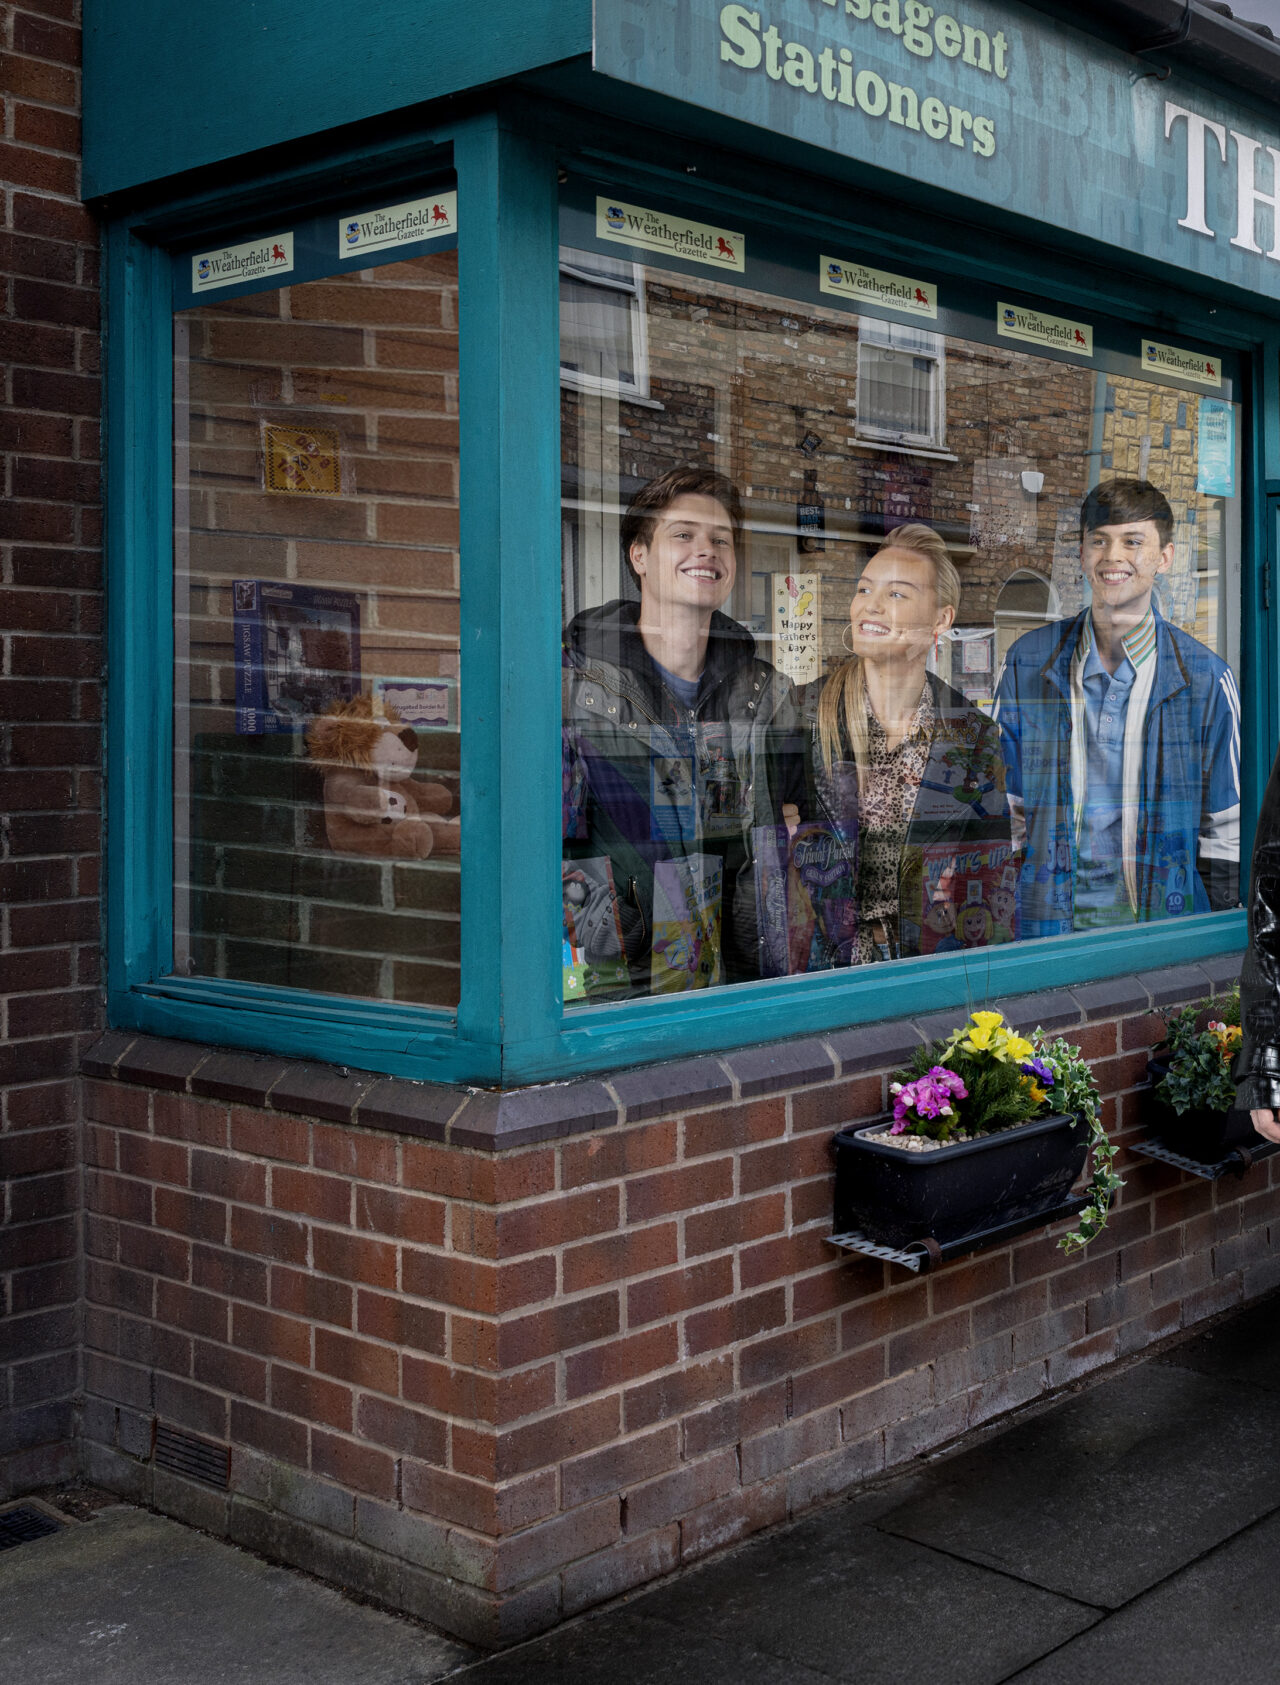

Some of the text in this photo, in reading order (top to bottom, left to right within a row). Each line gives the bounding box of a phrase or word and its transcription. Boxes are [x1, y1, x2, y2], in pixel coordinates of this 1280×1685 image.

[822, 0, 1007, 78] agent
[720, 4, 996, 157] Stationers
[361, 208, 430, 238] Weatherfield
[374, 213, 386, 223] The
[645, 212, 659, 225] The
[397, 227, 425, 241] Gazette
[627, 214, 713, 251] Weatherfield
[222, 252, 233, 260] The
[674, 242, 708, 259] Gazette
[211, 248, 270, 274] Weatherfield
[857, 268, 870, 279] The
[844, 270, 912, 301] Weatherfield
[1028, 312, 1038, 321] The
[1016, 314, 1072, 341] Weatherfield
[1158, 350, 1204, 373] Weatherfield
[781, 620, 813, 631] Happy
[241, 624, 251, 657] JIGSAW
[779, 632, 816, 641] Father's
[788, 643, 807, 654] Day
[1168, 895, 1182, 905] 10
